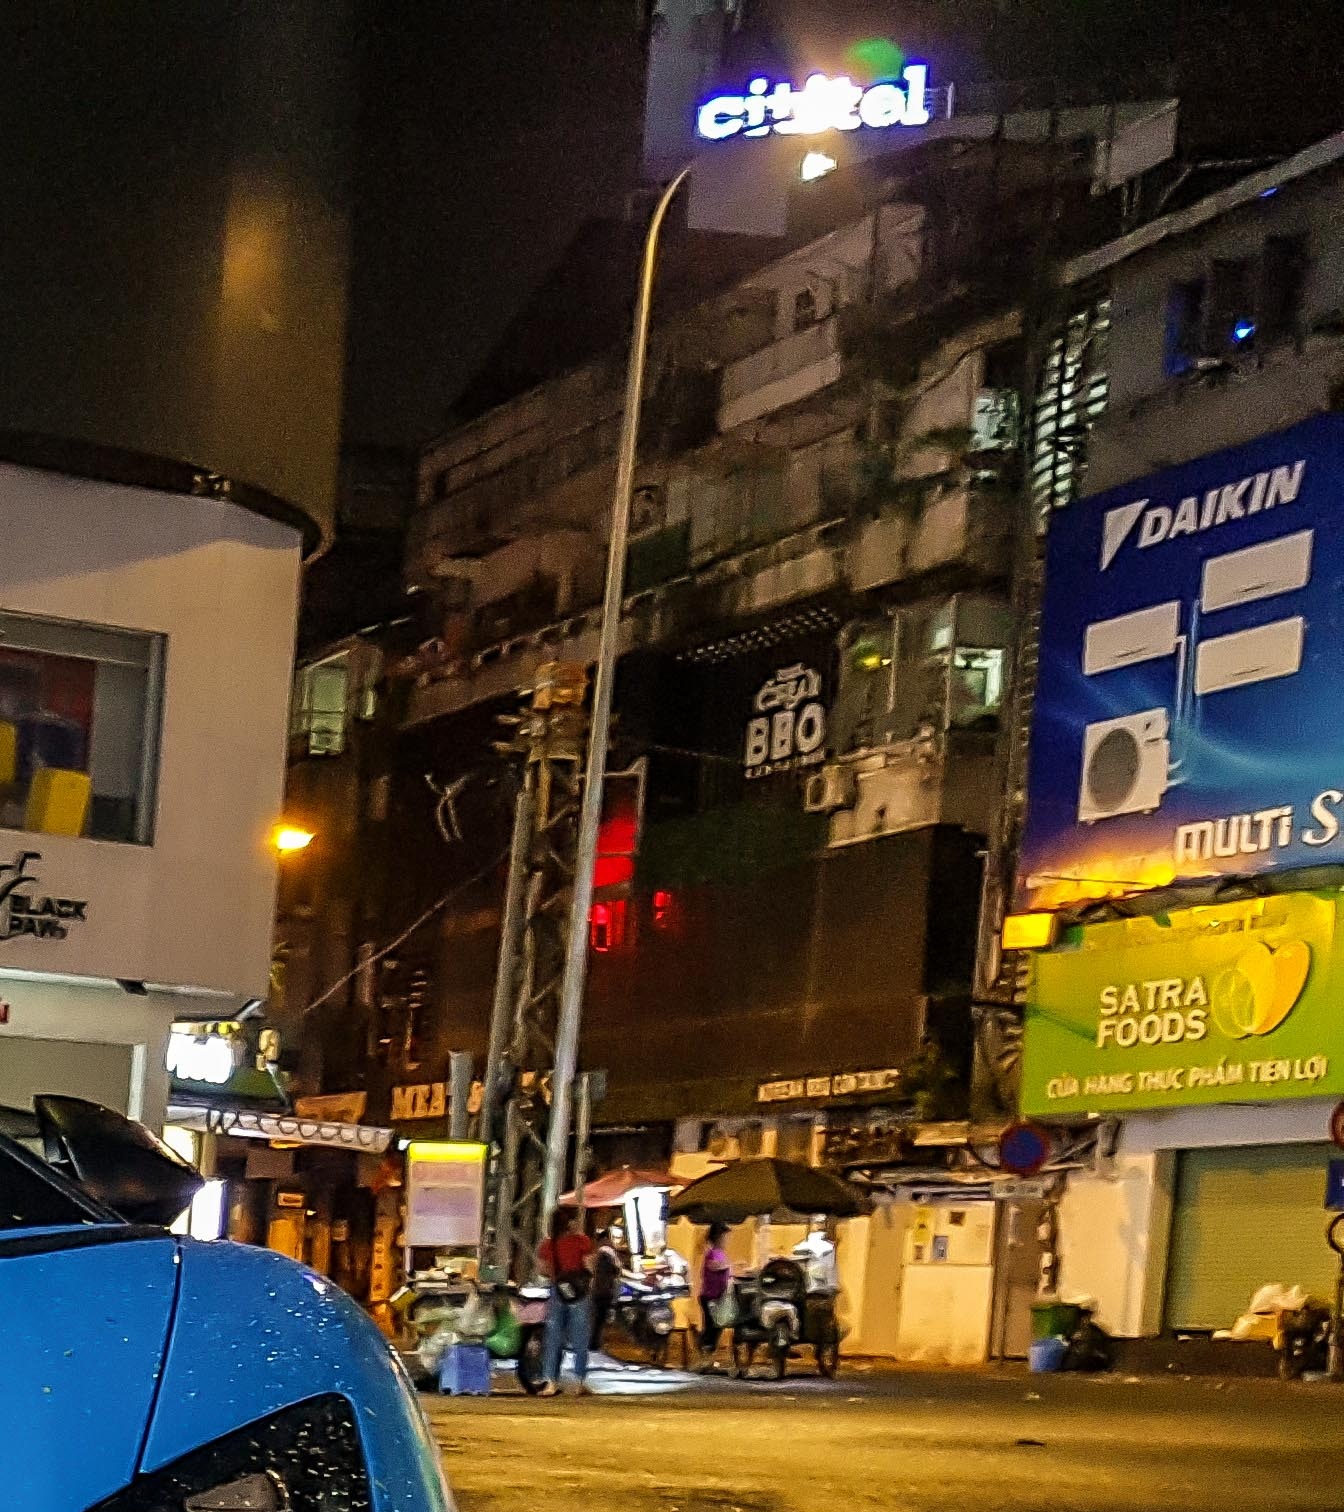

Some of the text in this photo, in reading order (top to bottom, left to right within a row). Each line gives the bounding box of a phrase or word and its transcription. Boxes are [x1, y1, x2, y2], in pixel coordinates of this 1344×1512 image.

[1137, 460, 1306, 550] DAIKIN
[1099, 975, 1209, 1015] SATRA
[1095, 1008, 1209, 1048] FOODS
